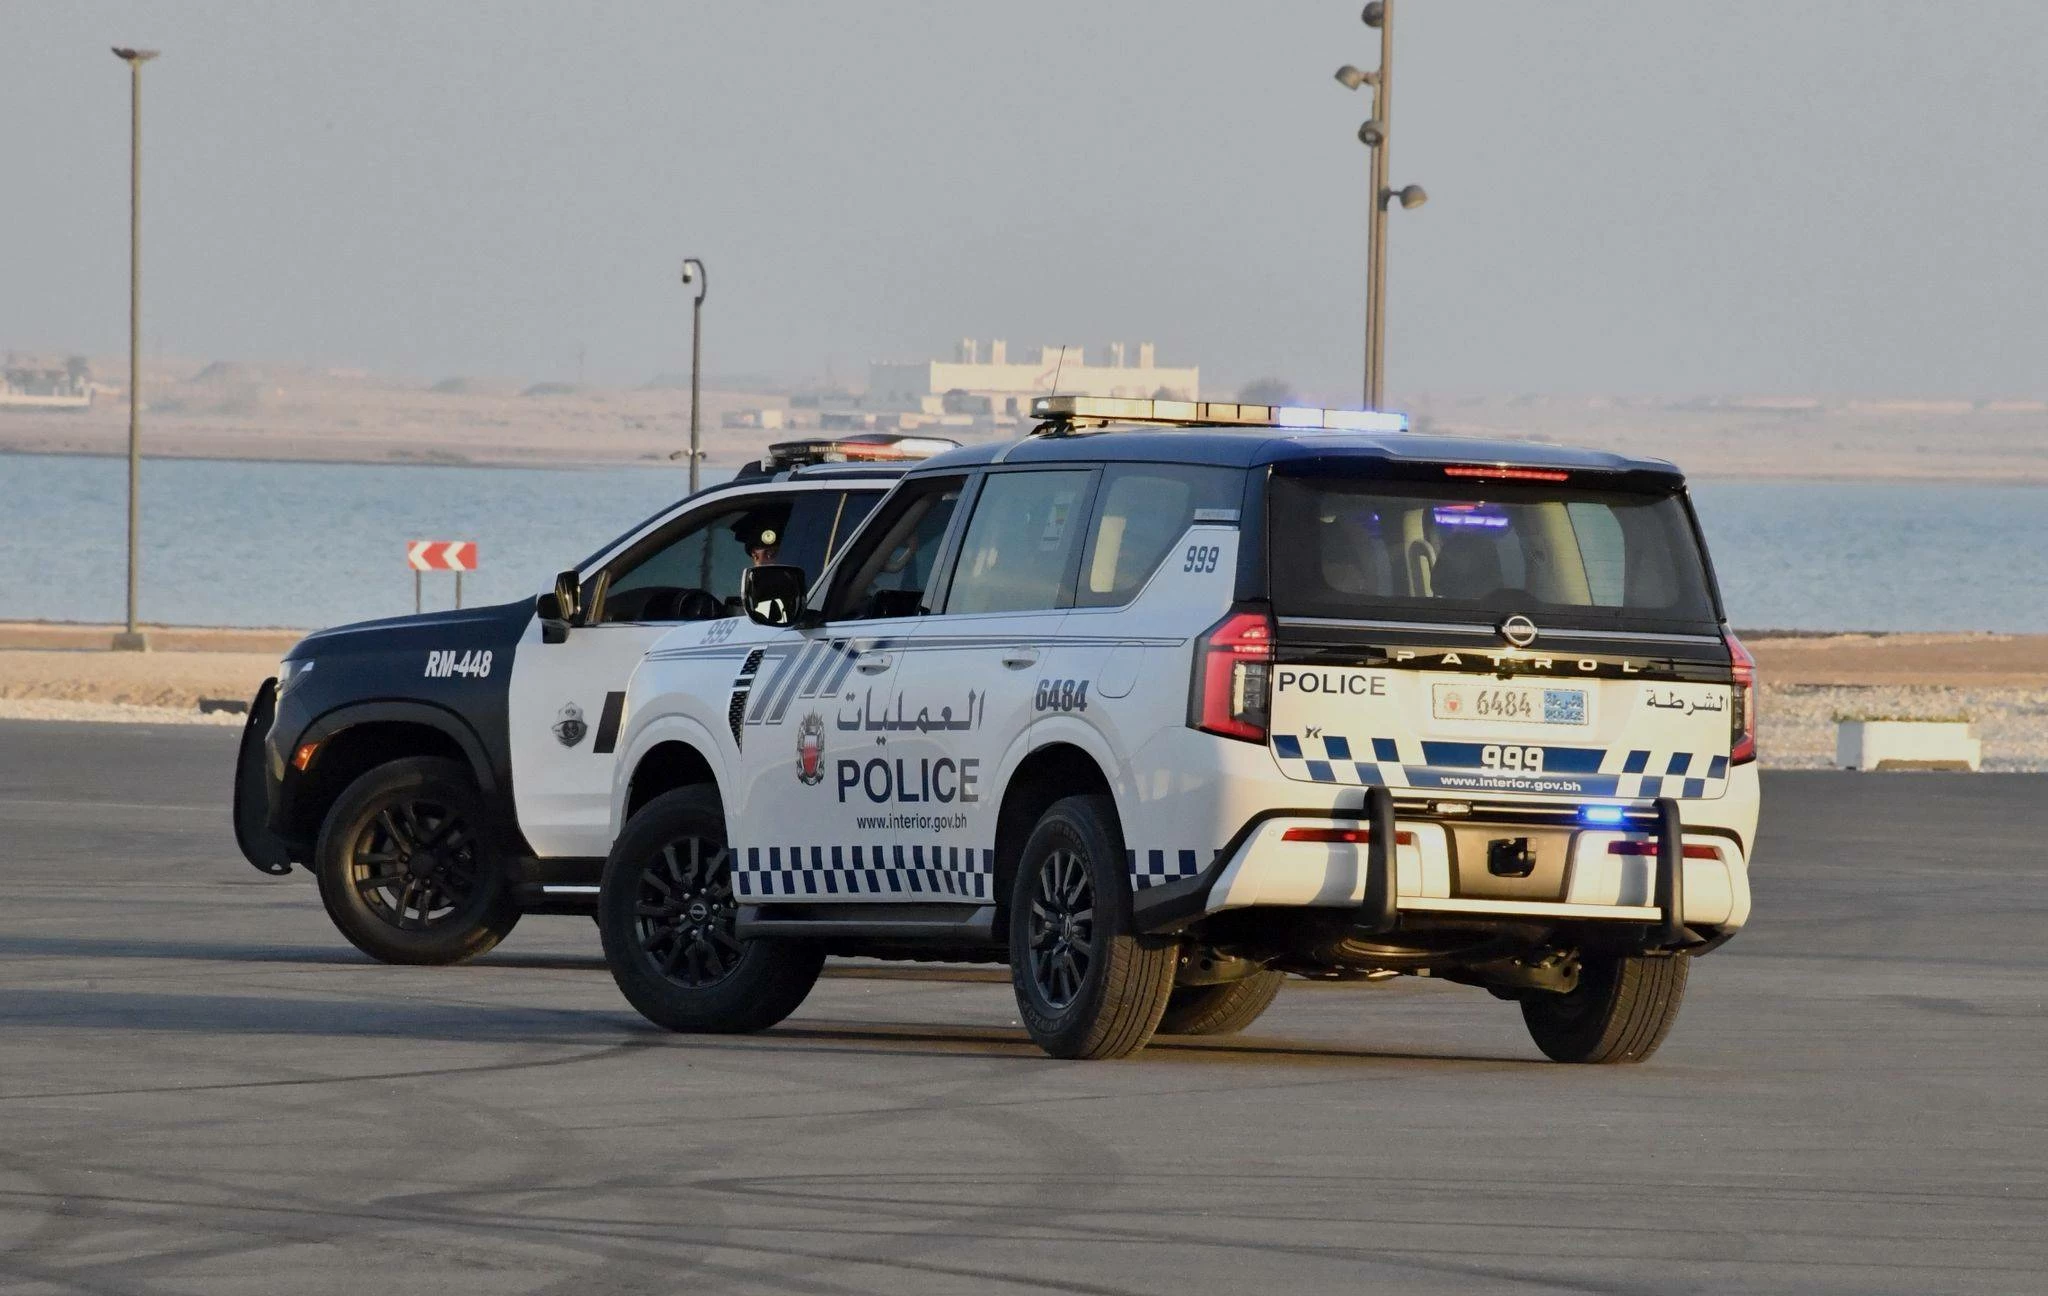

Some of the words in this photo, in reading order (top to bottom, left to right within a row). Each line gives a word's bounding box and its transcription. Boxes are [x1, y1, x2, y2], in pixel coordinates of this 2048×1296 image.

[1183, 545, 1220, 574] 999
[699, 618, 740, 645] 999
[424, 650, 493, 678] RM-448
[1396, 650, 1640, 674] PATROL
[1035, 679, 1090, 712] 6484
[1278, 671, 1386, 696] POLICE
[836, 685, 986, 746] العمليات
[1476, 690, 1532, 718] 6484
[1645, 688, 1729, 716] الشرطة
[1480, 745, 1545, 779] 999
[837, 757, 980, 804] POLICE
[1440, 775, 1582, 792] www.interior.gov.bh
[856, 812, 968, 833] www.interior.gov.bh
